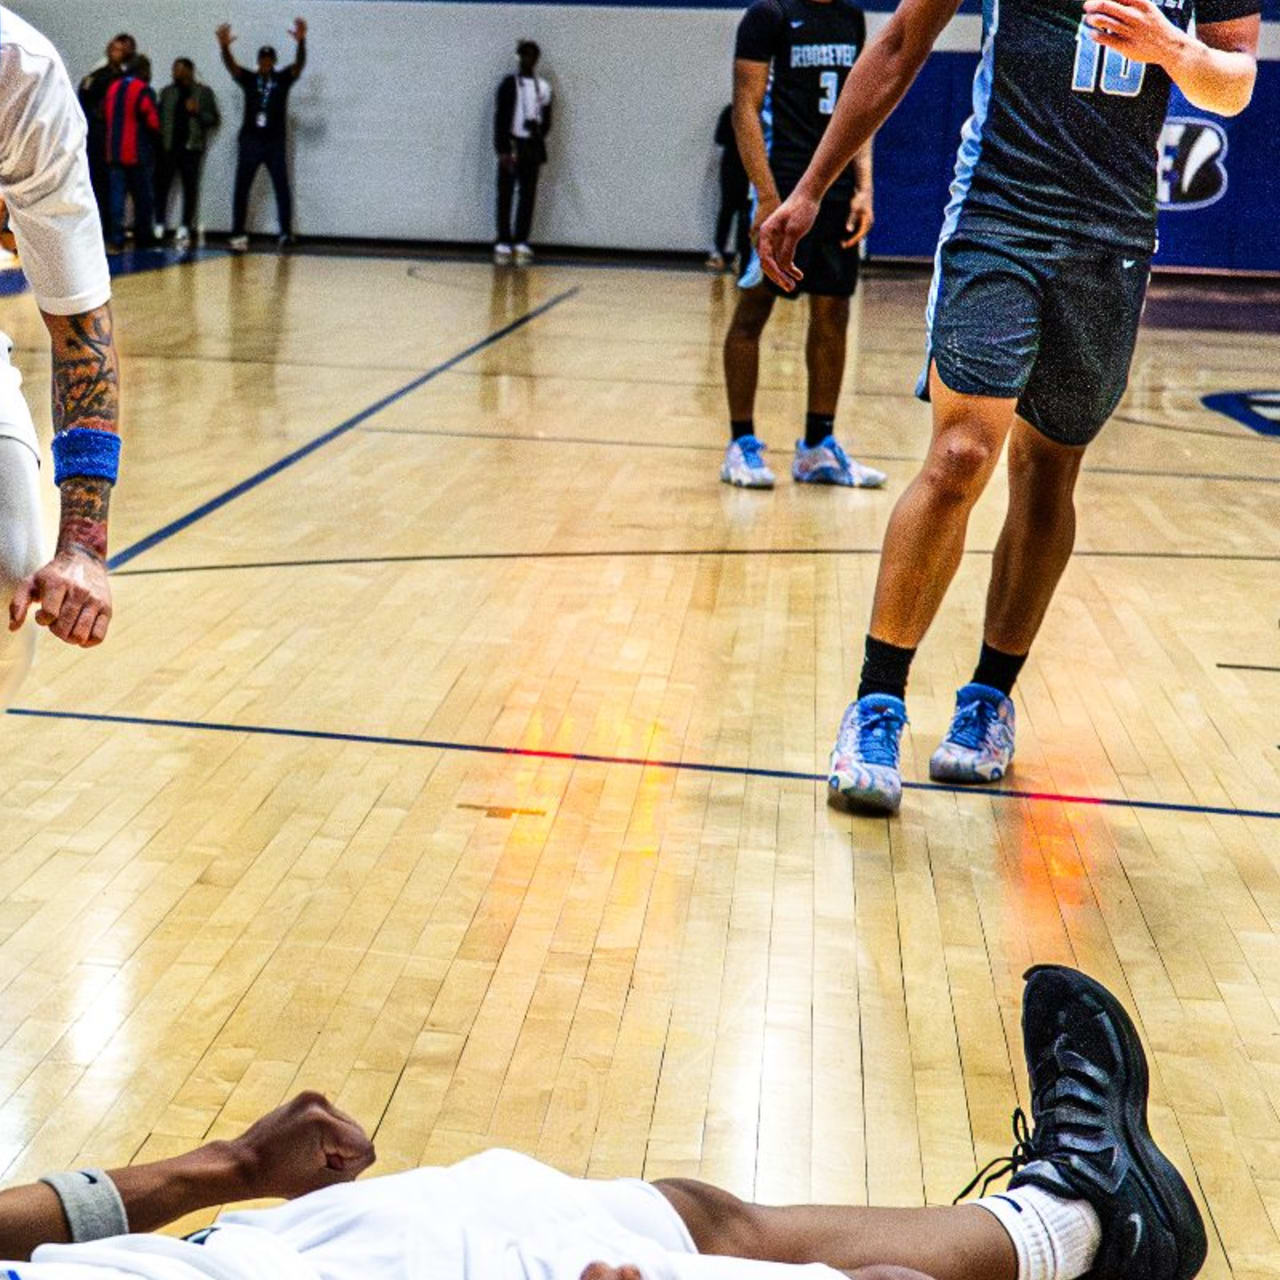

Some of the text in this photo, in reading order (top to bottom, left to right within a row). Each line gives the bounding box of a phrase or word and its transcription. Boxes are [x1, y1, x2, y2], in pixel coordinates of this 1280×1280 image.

[791, 44, 857, 68] ROOSEVEL
[1071, 14, 1146, 97] 10
[818, 71, 839, 114] 3
